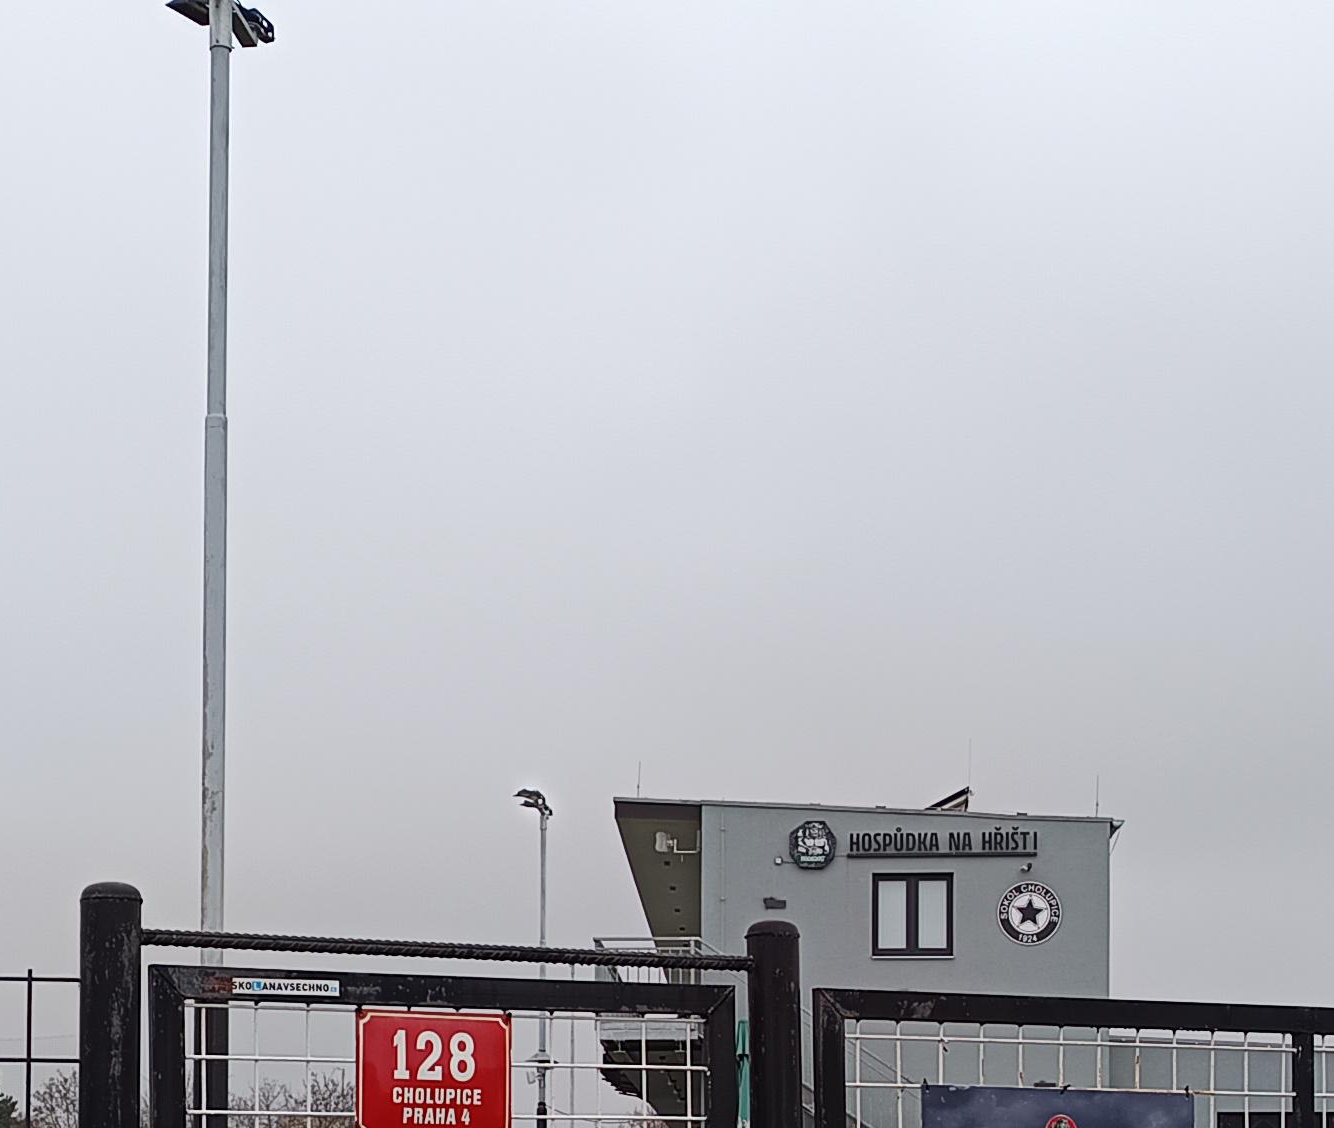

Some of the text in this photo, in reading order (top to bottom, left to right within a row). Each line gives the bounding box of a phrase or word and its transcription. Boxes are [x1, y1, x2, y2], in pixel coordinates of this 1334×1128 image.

[849, 826, 1038, 852] HOSPŮDKA NA HŘIŠTI
[1000, 884, 1059, 923] SOKOL CHOLUPICE
[1018, 934, 1038, 943] 1924
[393, 1029, 476, 1082] 128
[392, 1087, 482, 1105] CHOLUPICE
[402, 1107, 471, 1125] PRAHA 4
